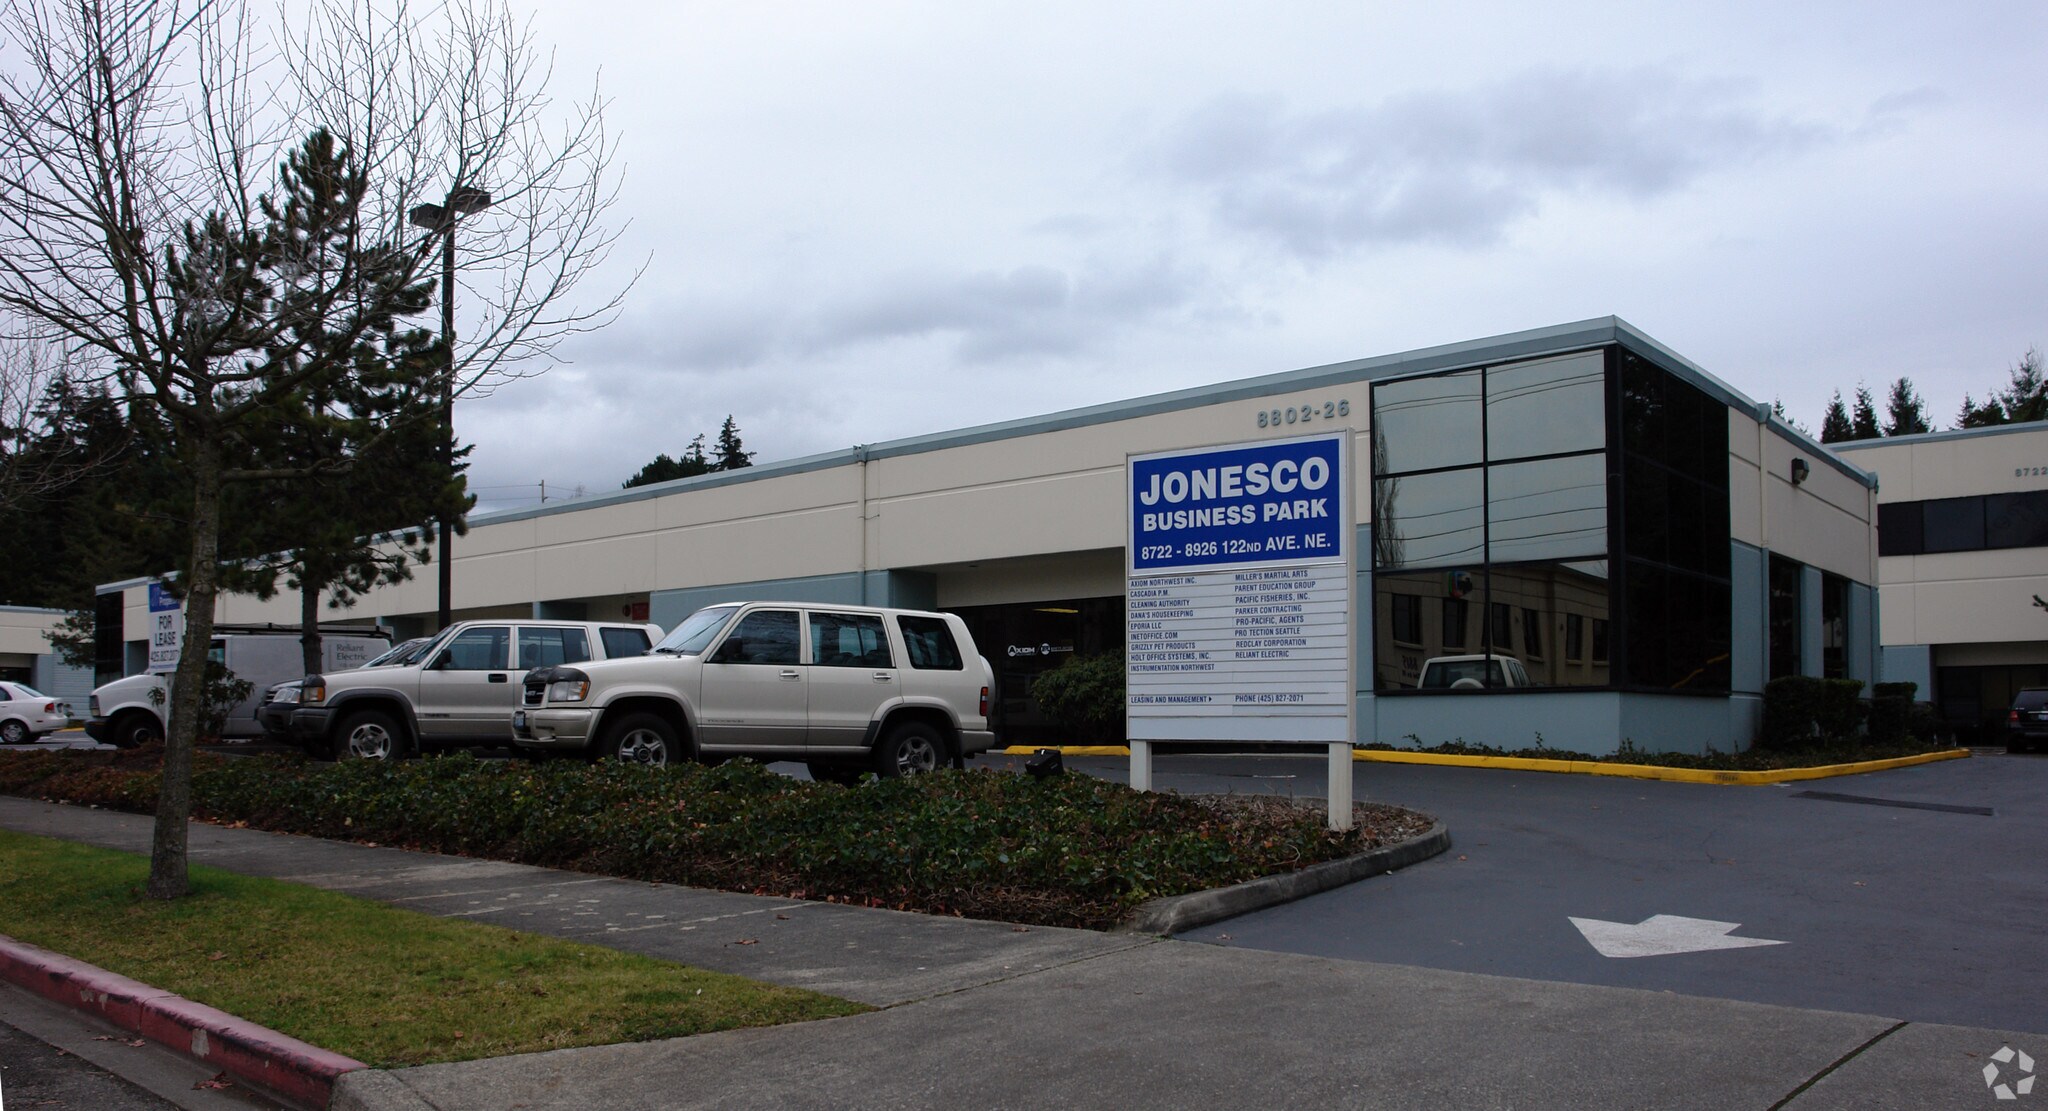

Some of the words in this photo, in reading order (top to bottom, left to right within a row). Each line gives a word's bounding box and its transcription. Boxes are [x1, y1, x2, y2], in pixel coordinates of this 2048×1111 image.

[1257, 399, 1349, 428] 8802-26
[1140, 456, 1330, 506] JONESCO
[1143, 504, 1256, 532] BUSINESS
[1263, 498, 1328, 522] PARK
[1141, 544, 1172, 560] 8722
[1185, 541, 1217, 557] 8926
[1266, 535, 1300, 551] AVE.
[1304, 533, 1331, 548] NE.
[1235, 573, 1263, 581] MILLER'S
[1264, 571, 1290, 579] MARTIAL
[1292, 570, 1308, 578] ARTS
[1149, 578, 1184, 586] NORTHWEST
[1234, 584, 1258, 592] PARENT
[1259, 583, 1293, 591] EDUCATION
[1294, 581, 1316, 589] GROUP
[1130, 590, 1156, 598] CASCADIA
[1235, 596, 1259, 604] PACIFIC
[1152, 610, 1194, 618] HOUSEKEEPING
[1235, 607, 1258, 615] PARKER
[1260, 605, 1302, 613] CONTRACTING
[159, 615, 173, 630] FOR
[1130, 622, 1150, 630] EPORIA
[155, 632, 176, 646] LEASE
[1130, 632, 1178, 640] INETOFFICE.COM
[336, 643, 365, 652] Reliant
[1236, 640, 1262, 648] REDCLAY
[1264, 638, 1307, 646] CORPORATION
[1008, 645, 1035, 656] AXIOM
[1261, 650, 1290, 658] ELECTRIC
[336, 652, 369, 661] Electric
[1130, 664, 1180, 672] INSTRUMENTATION
[1168, 695, 1207, 703] MANAGEMENT
[1258, 694, 1274, 703] (425)
